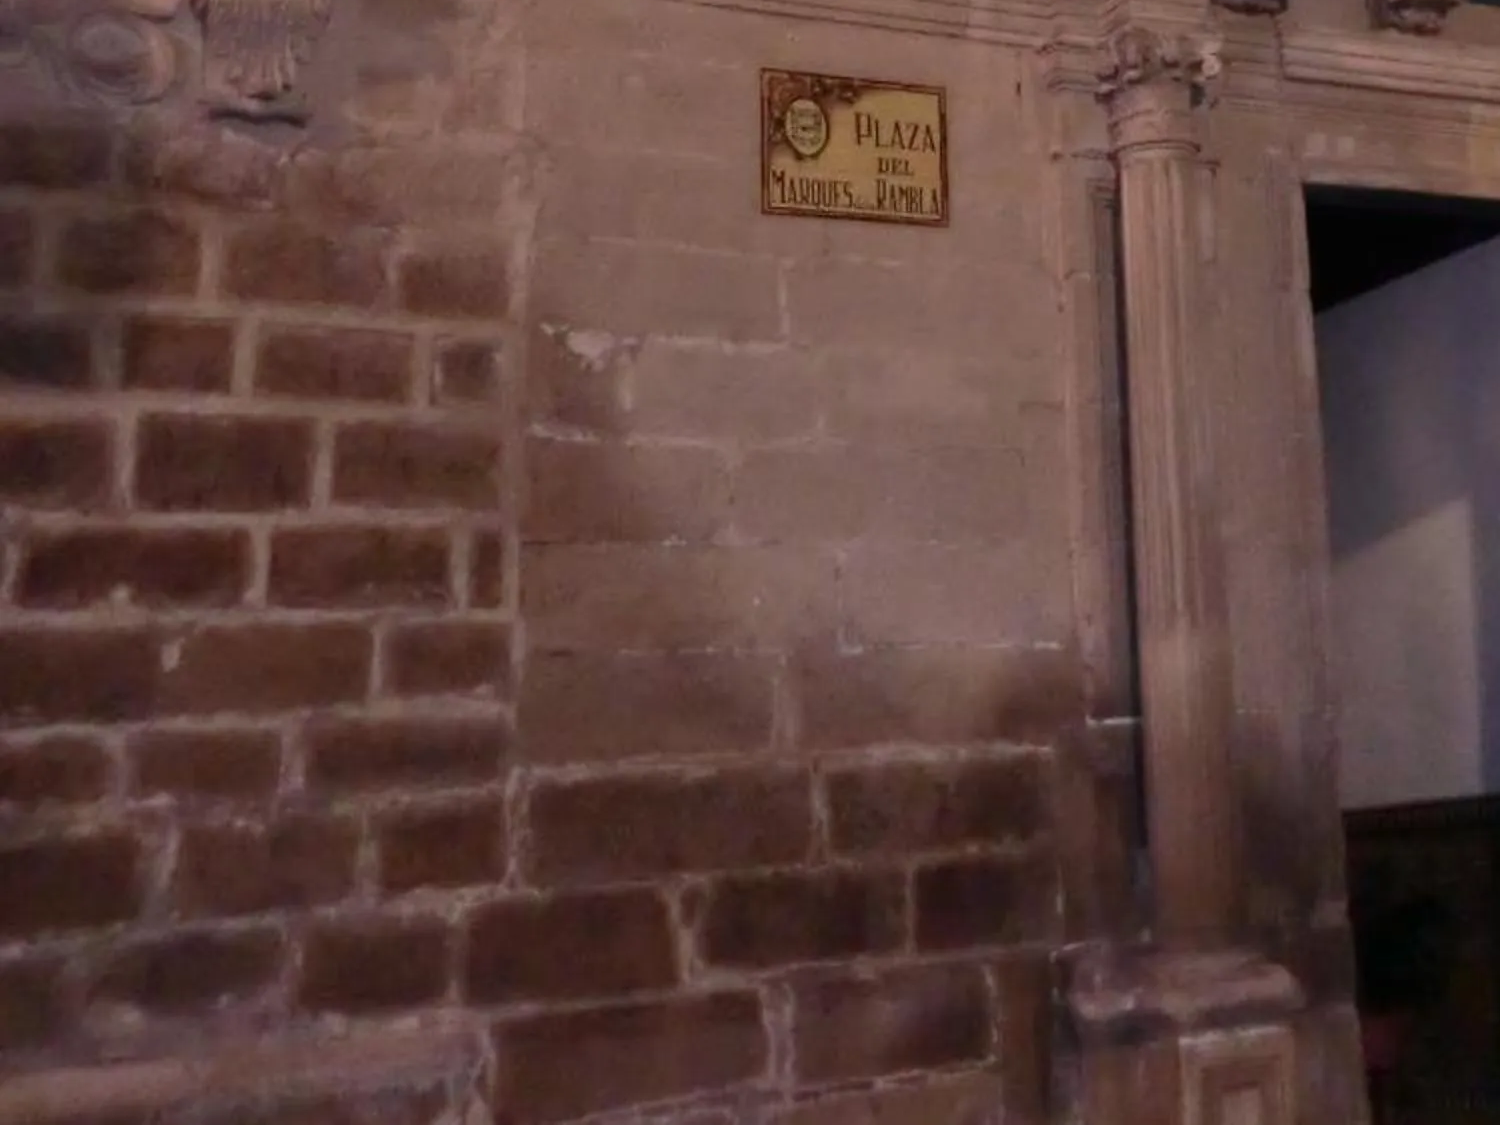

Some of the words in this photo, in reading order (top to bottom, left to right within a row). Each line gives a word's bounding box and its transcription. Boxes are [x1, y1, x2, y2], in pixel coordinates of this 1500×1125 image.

[854, 111, 937, 153] PLAZA
[877, 157, 914, 176] DEL
[876, 178, 940, 215] RAMBLA
